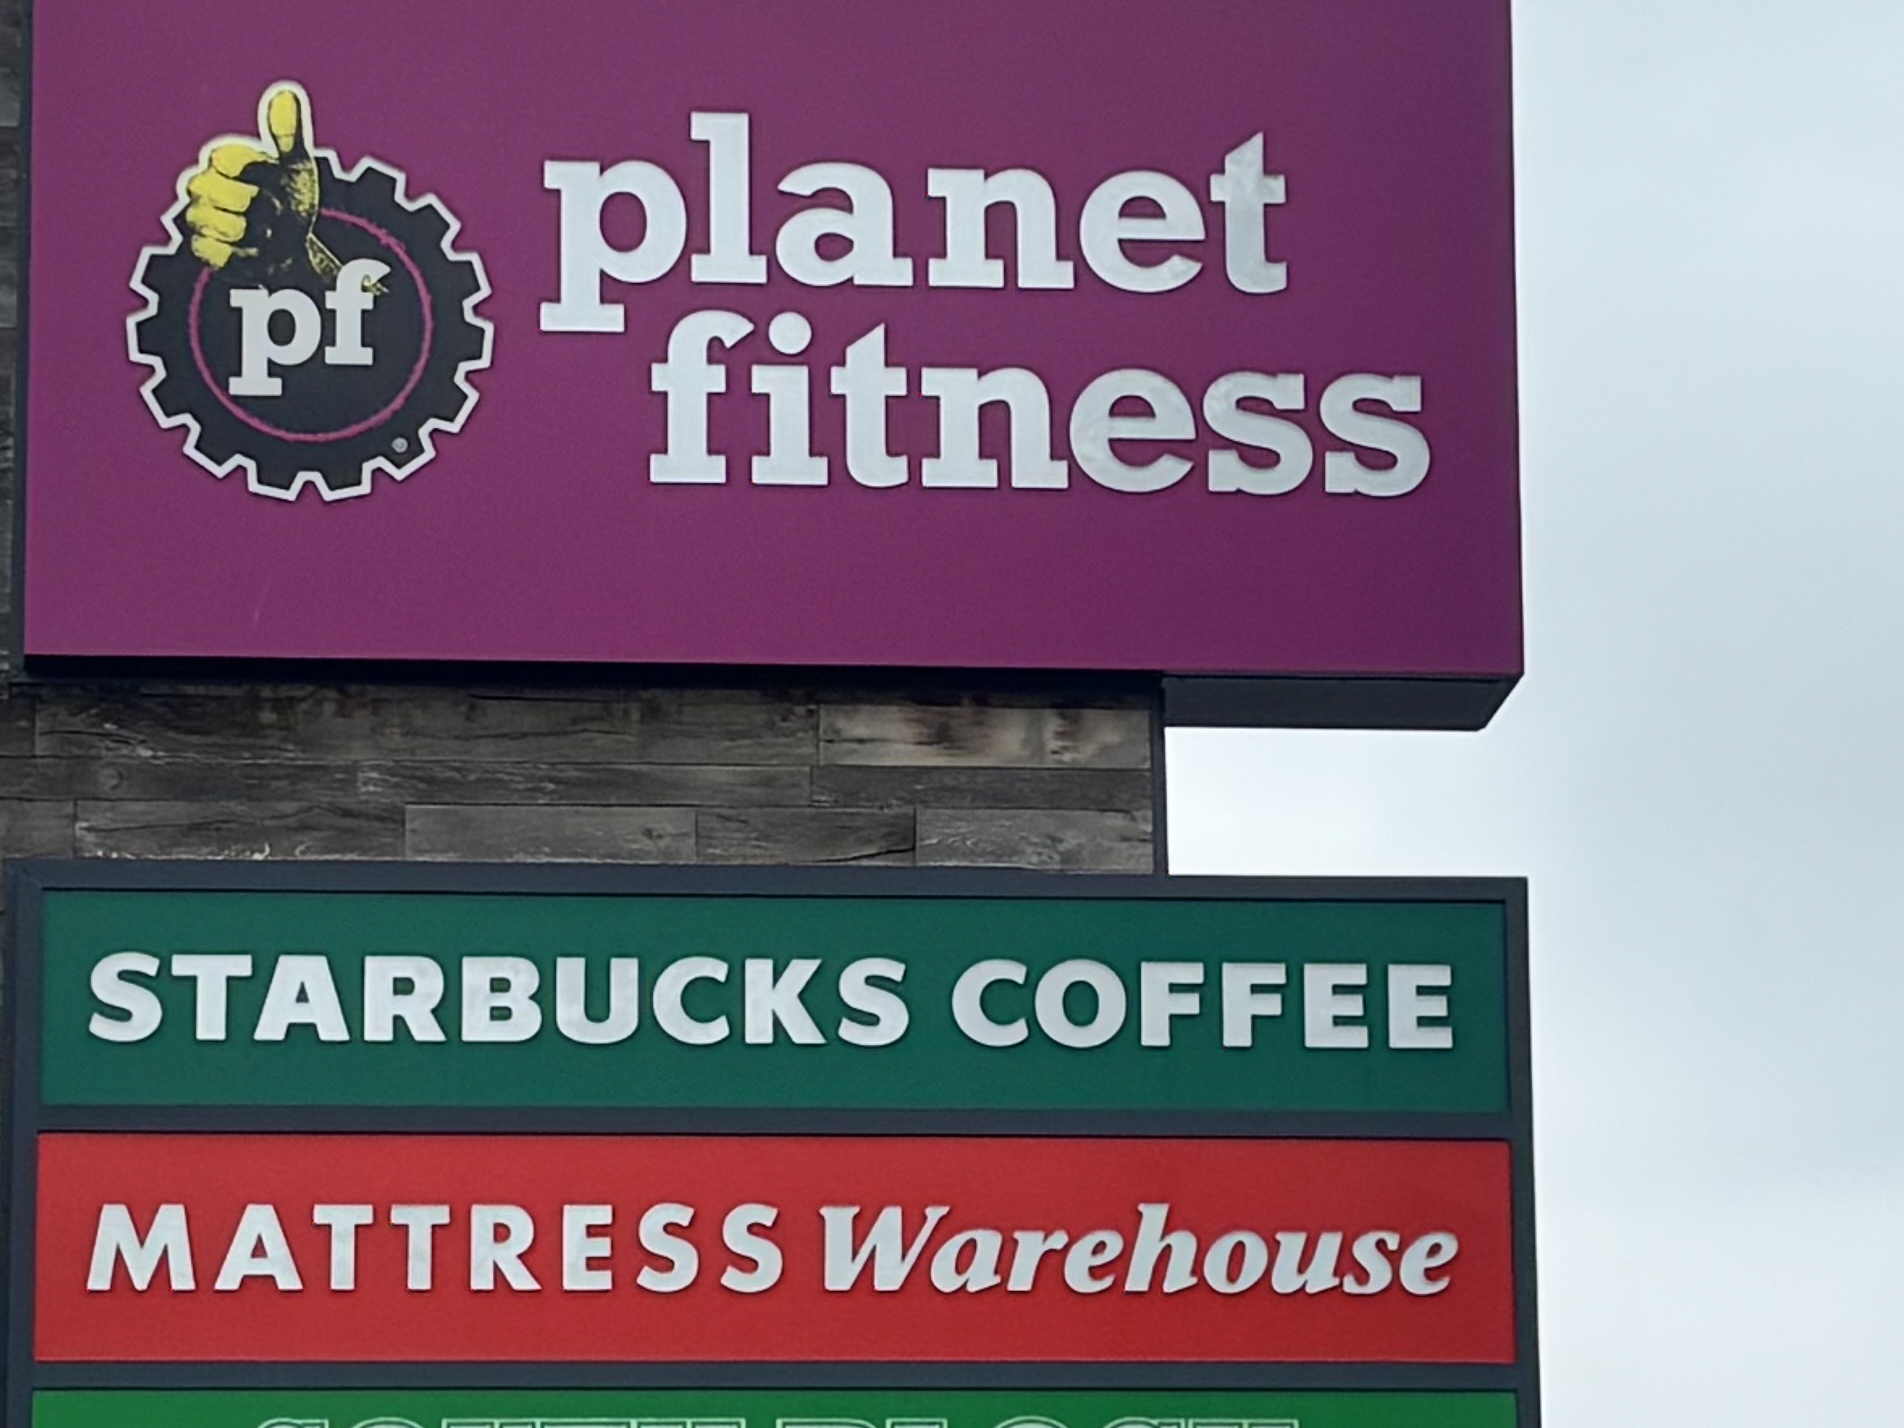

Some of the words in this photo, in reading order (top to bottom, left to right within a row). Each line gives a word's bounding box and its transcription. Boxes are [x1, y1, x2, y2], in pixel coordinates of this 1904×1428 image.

[538, 111, 1288, 334] planet
[228, 257, 390, 397] pf
[648, 309, 1432, 498] fitness
[87, 951, 911, 1047] STARBUCKS
[951, 959, 1454, 1049] COFFEE
[86, 1202, 785, 1294] MATTRESS
[818, 1202, 1460, 1296] Warehouse
